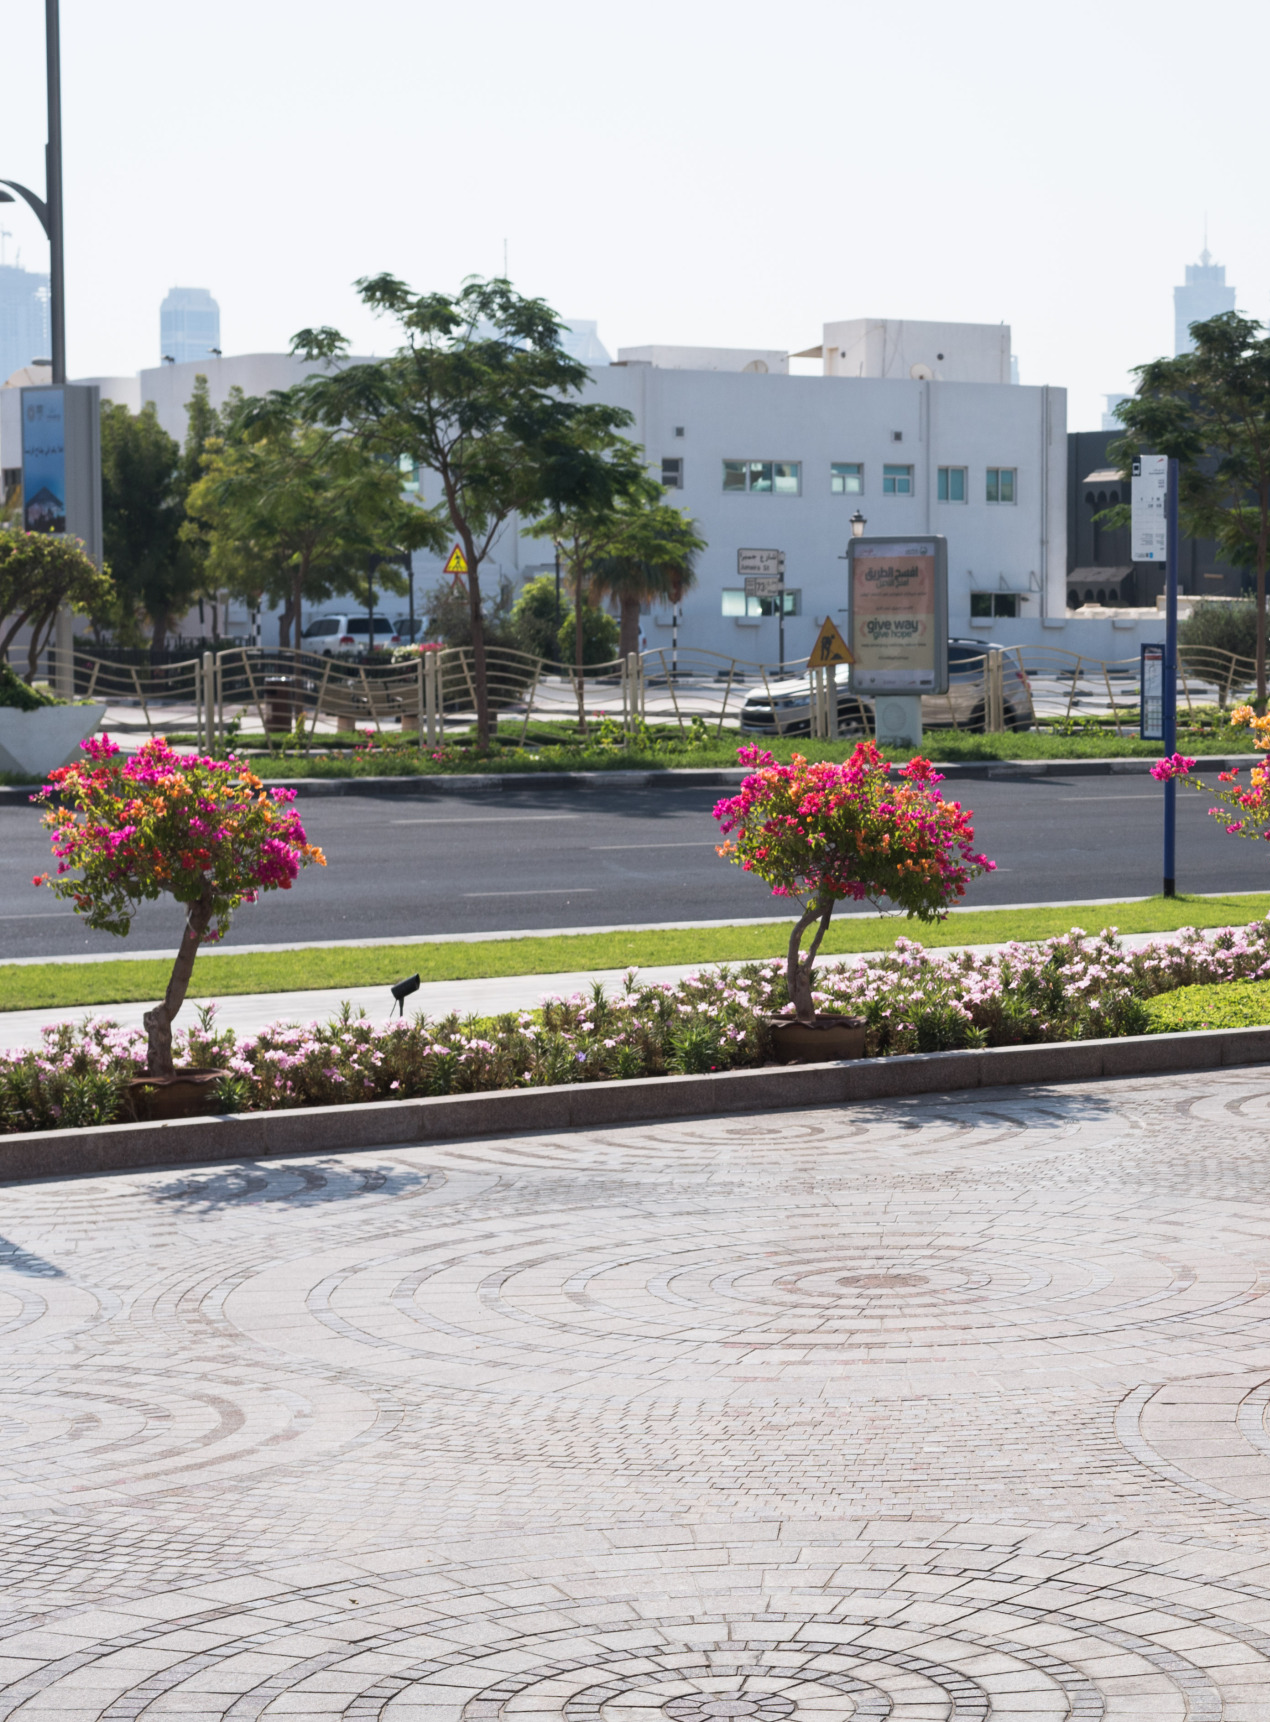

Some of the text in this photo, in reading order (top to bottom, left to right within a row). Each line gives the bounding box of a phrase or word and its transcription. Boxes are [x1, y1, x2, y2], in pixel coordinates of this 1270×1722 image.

[867, 617, 919, 634] give way
[873, 630, 912, 640] give hope
